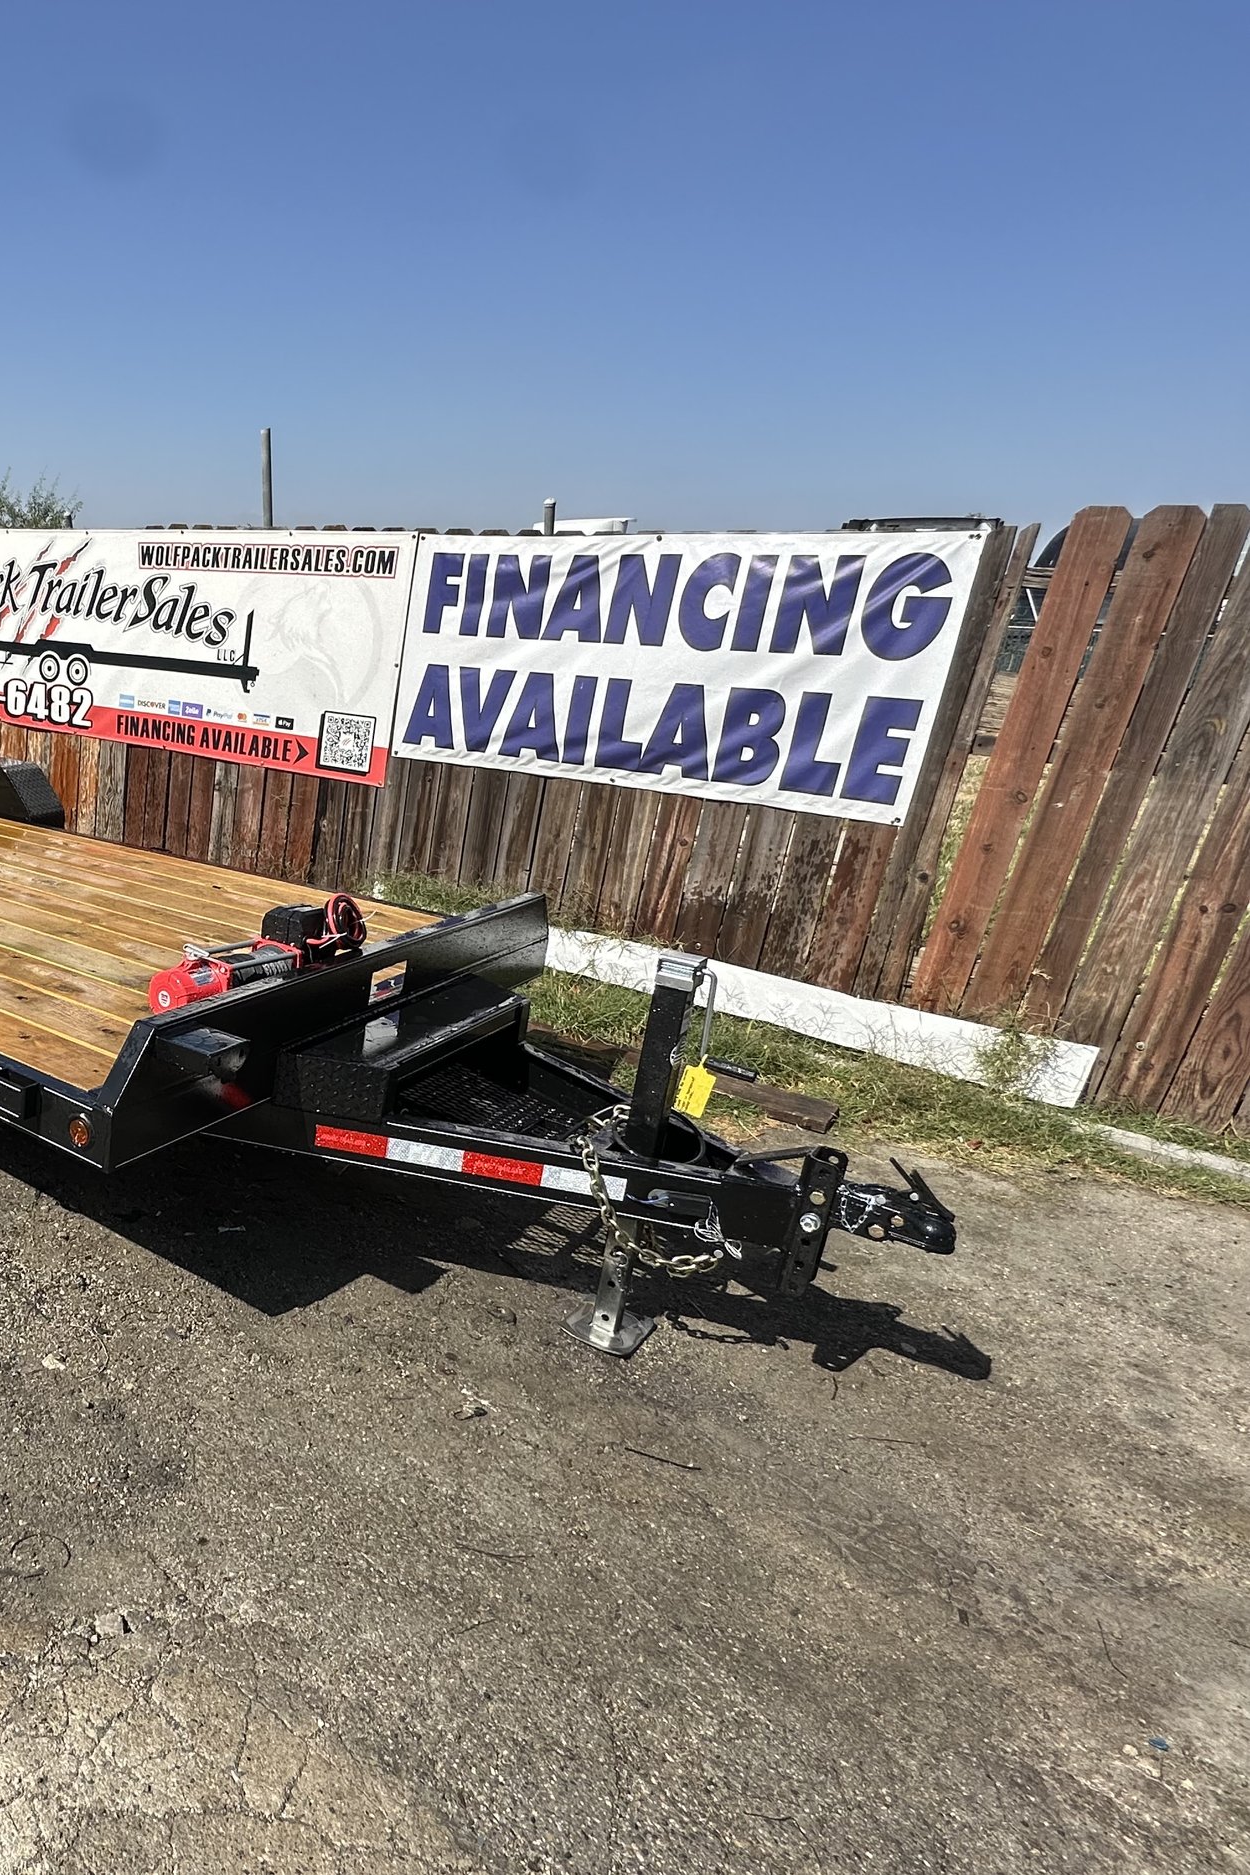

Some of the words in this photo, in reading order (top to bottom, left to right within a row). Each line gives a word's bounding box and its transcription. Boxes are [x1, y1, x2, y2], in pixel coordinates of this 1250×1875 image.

[141, 545, 396, 575] WOLFPACKTRAILERSALES.COM
[422, 552, 953, 661] FINANCING
[217, 649, 236, 662] LLC
[116, 714, 196, 747] FINANCING
[199, 726, 293, 763] AVAILABLE
[403, 664, 924, 806] AVAILABLE
